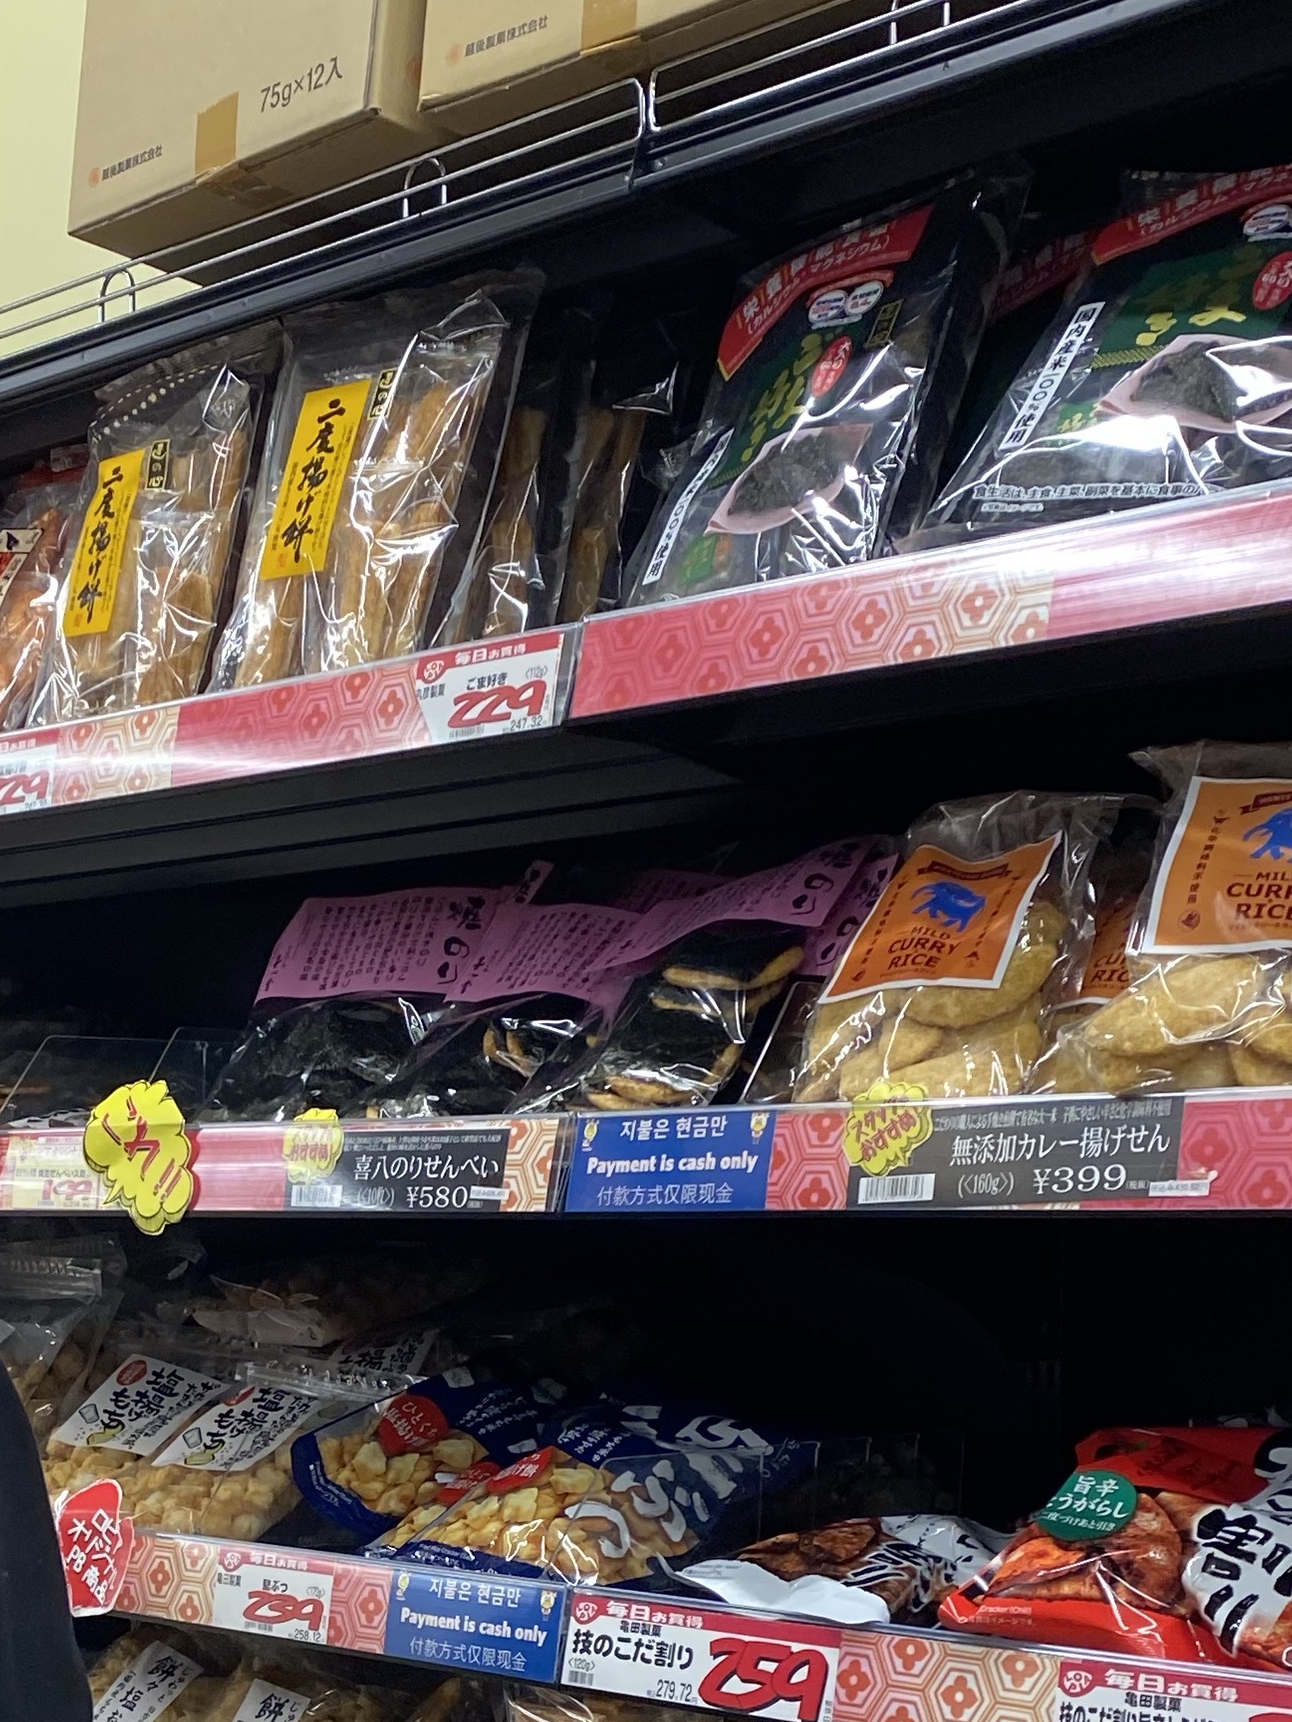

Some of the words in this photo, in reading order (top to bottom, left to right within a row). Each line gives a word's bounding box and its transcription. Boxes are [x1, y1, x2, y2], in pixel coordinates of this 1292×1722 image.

[260, 56, 343, 112] 75g×12入
[281, 397, 348, 564] 二度揚げ餅
[455, 643, 526, 665] 毎日お買得
[466, 672, 508, 690] ごま好き
[447, 680, 547, 729] 229
[510, 714, 544, 731] 247.32
[910, 926, 951, 940] MILD
[888, 937, 962, 956] CURRY
[888, 953, 941, 971] RICE
[620, 1118, 669, 1139] 지불은
[676, 1115, 725, 1137] 현금만
[950, 1124, 1170, 1167] 無添加カレー揚げせん
[354, 1154, 499, 1182] 喜八のりせんべい
[587, 1155, 654, 1179] Payment
[659, 1155, 673, 1172] is
[678, 1154, 719, 1171] cash
[724, 1151, 758, 1174] only
[42, 1179, 93, 1201] 199
[1033, 1163, 1127, 1195] ¥399
[406, 1186, 468, 1208] ¥580
[596, 1182, 734, 1206] 付款方式仅限现金
[1074, 1475, 1119, 1498] 旨辛
[429, 1579, 473, 1602] 지불은
[477, 1584, 521, 1608] 현금만
[400, 1607, 459, 1634] Payment
[463, 1615, 476, 1633] is
[478, 1619, 512, 1639] cash
[513, 1622, 548, 1646] only
[606, 1600, 704, 1629] 毎日お買得
[619, 1620, 662, 1637] 亀田製菓
[409, 1637, 527, 1672] 付款方式仅限现金
[572, 1629, 695, 1670] 技のこだ割り
[655, 1679, 693, 1702] 279.72
[697, 1637, 830, 1722] 259
[1105, 1668, 1239, 1702] 毎日お買得
[1125, 1692, 1183, 1712] 亀田製菓
